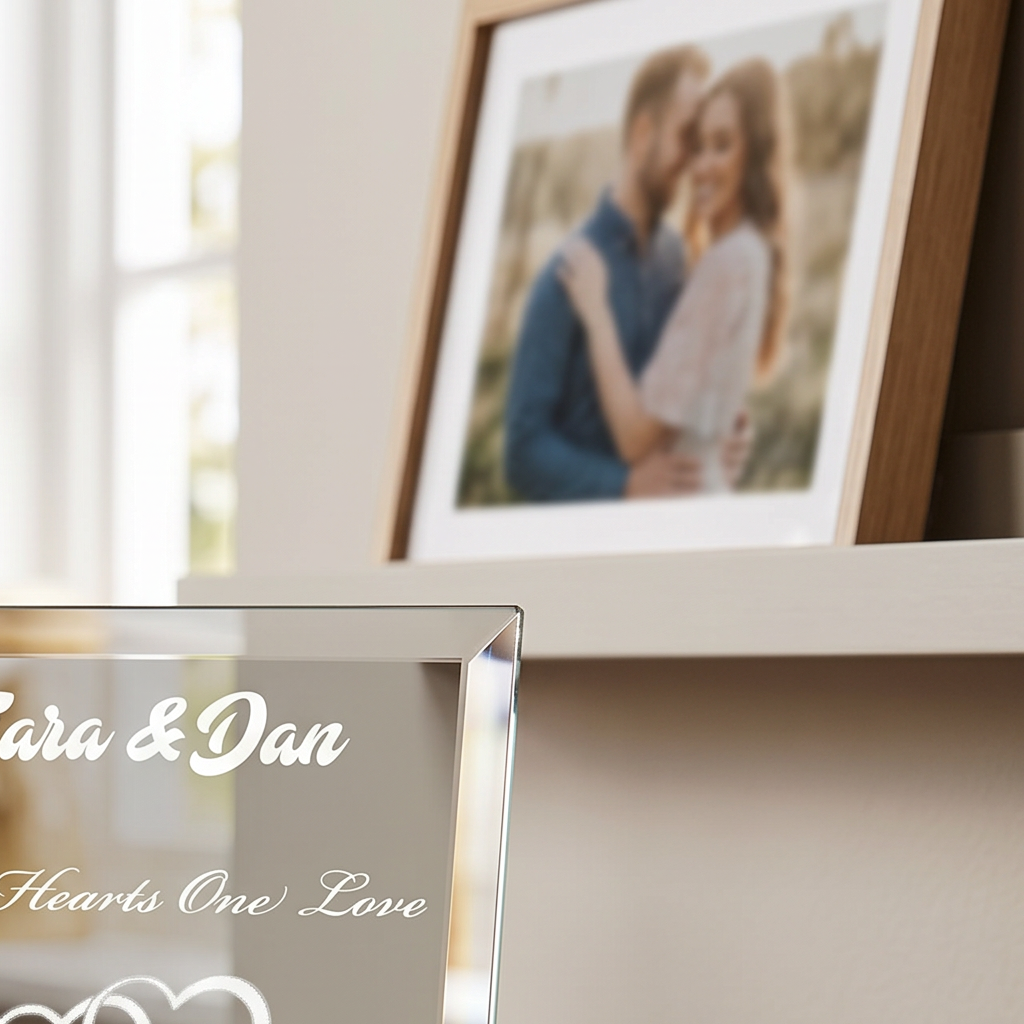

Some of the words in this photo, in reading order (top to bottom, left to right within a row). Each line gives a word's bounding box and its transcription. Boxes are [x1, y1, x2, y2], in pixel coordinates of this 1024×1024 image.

[189, 691, 350, 777] Dan
[178, 869, 288, 916] One
[297, 869, 428, 918] Love
